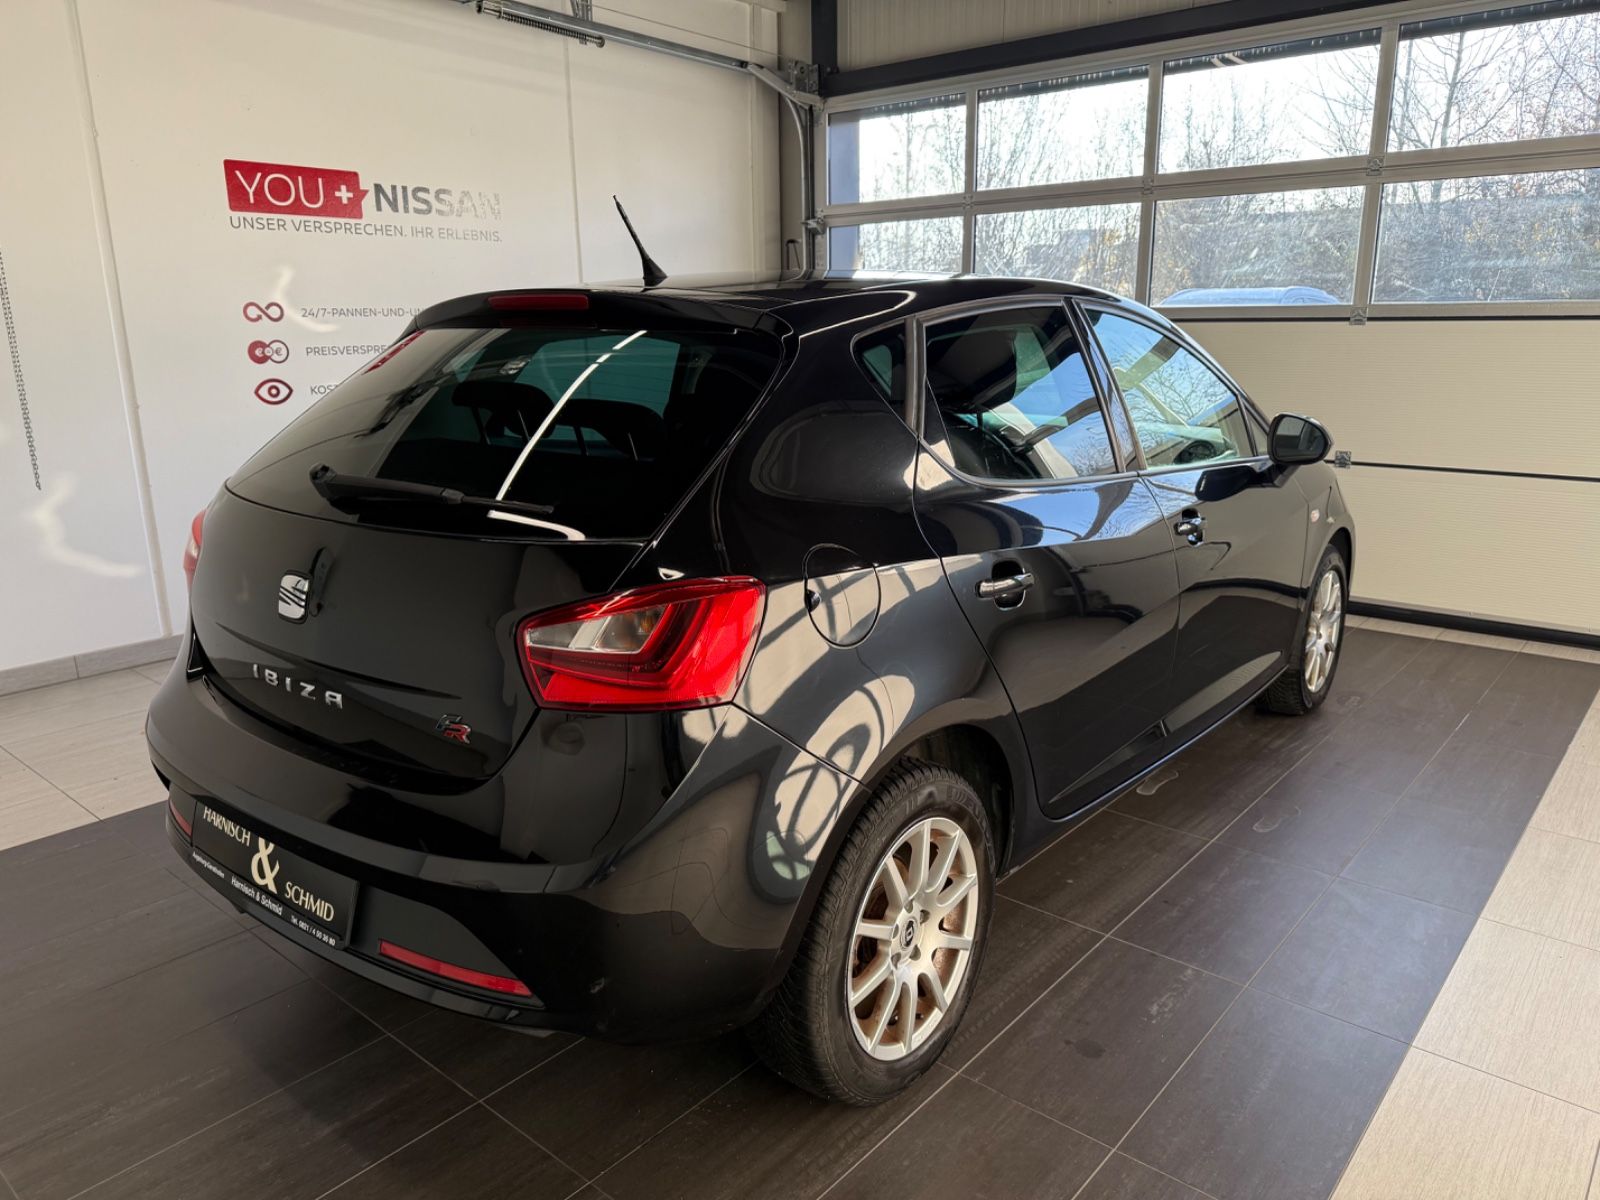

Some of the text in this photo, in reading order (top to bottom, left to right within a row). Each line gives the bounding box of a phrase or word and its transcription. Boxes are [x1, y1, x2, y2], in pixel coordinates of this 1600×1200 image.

[235, 170, 324, 209] YOU
[373, 183, 501, 221] NISSAN
[229, 216, 503, 243] UNSER VERSPRECHEN. IHR ERLEBNIS.
[252, 663, 343, 710] IBIZA
[203, 806, 335, 922] HARNISCH & SCHMID
[231, 875, 256, 899] Harnisch
[260, 895, 283, 916] Schmid
